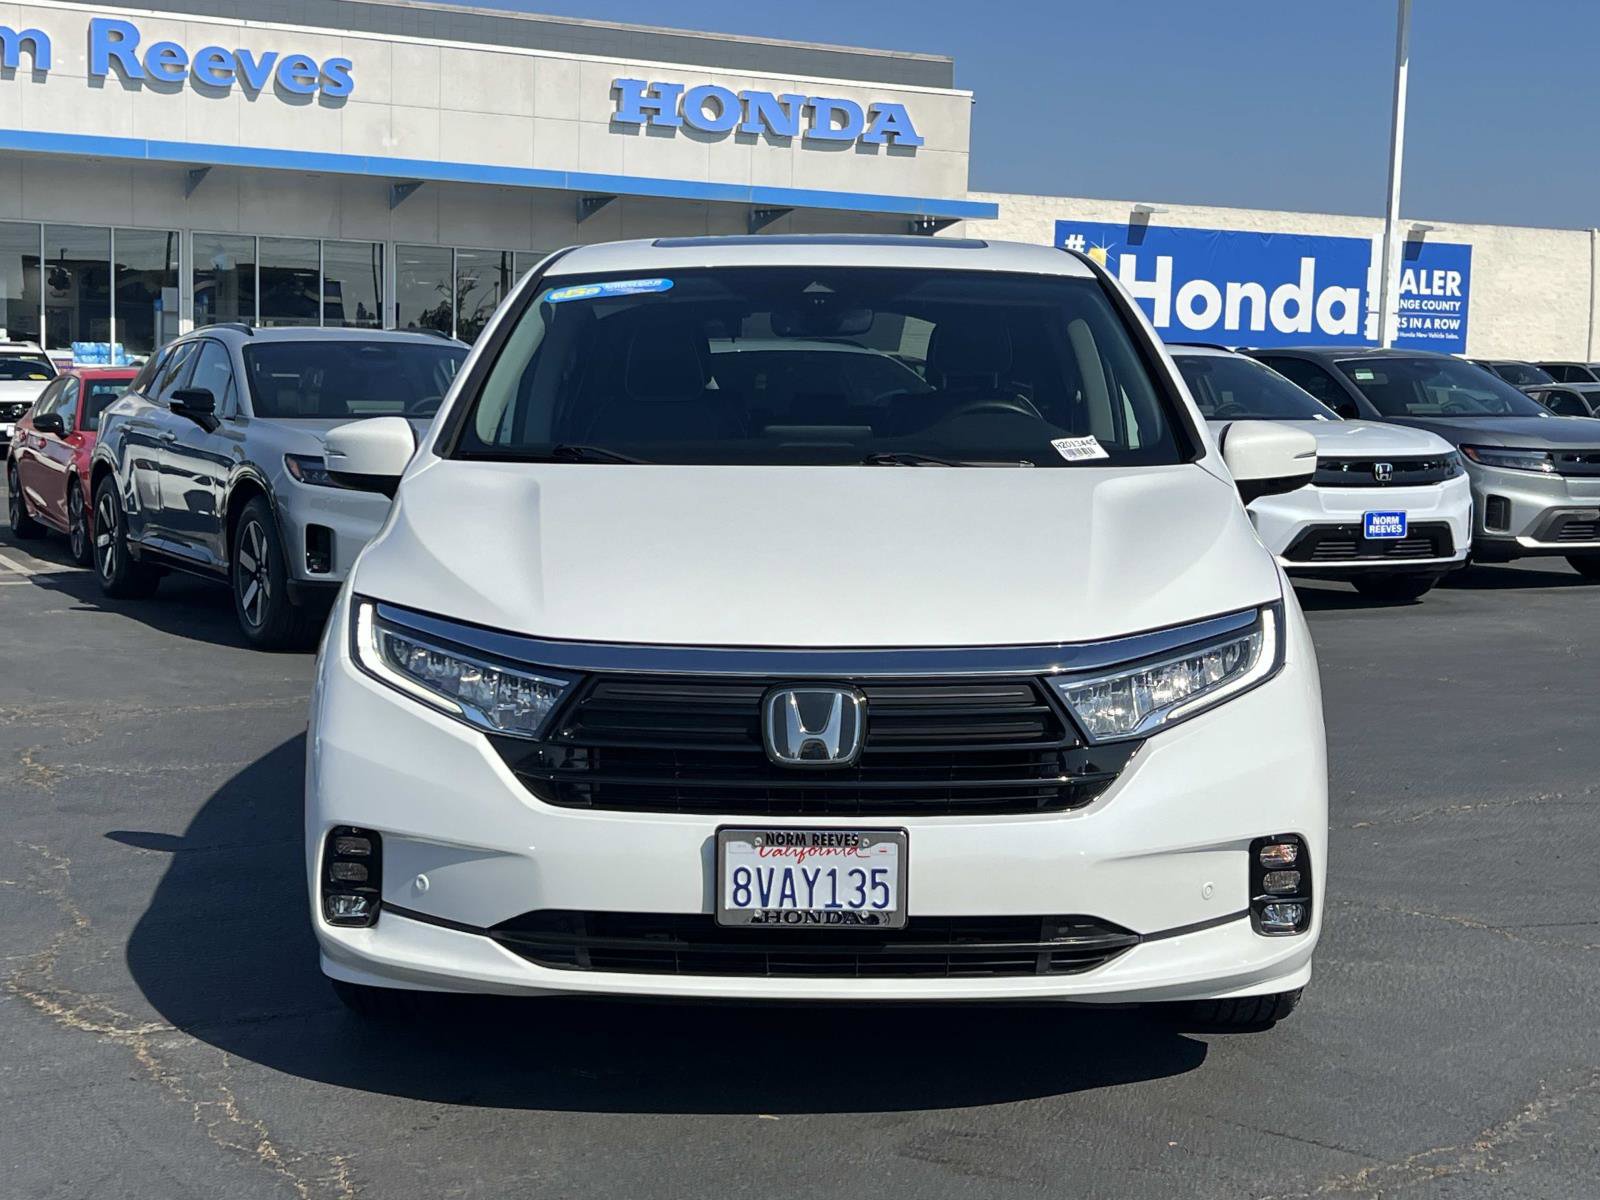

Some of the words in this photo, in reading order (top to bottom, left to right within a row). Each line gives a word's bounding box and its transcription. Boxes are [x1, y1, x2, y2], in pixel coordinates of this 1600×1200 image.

[90, 17, 355, 97] Reeves
[610, 78, 925, 147] HONDA
[1400, 269, 1462, 296] ALER
[1118, 253, 1360, 336] Honda
[1422, 301, 1461, 311] COUNTY
[1409, 317, 1422, 328] IN
[1423, 318, 1432, 329] A
[1434, 318, 1461, 330] ROW
[1372, 516, 1400, 525] NORM
[1369, 525, 1402, 533] REEVES
[765, 832, 806, 846] NORM
[812, 832, 859, 846] REEVES
[759, 846, 870, 864] California
[733, 866, 890, 909] 8VAY135
[763, 911, 863, 924] HONDA
